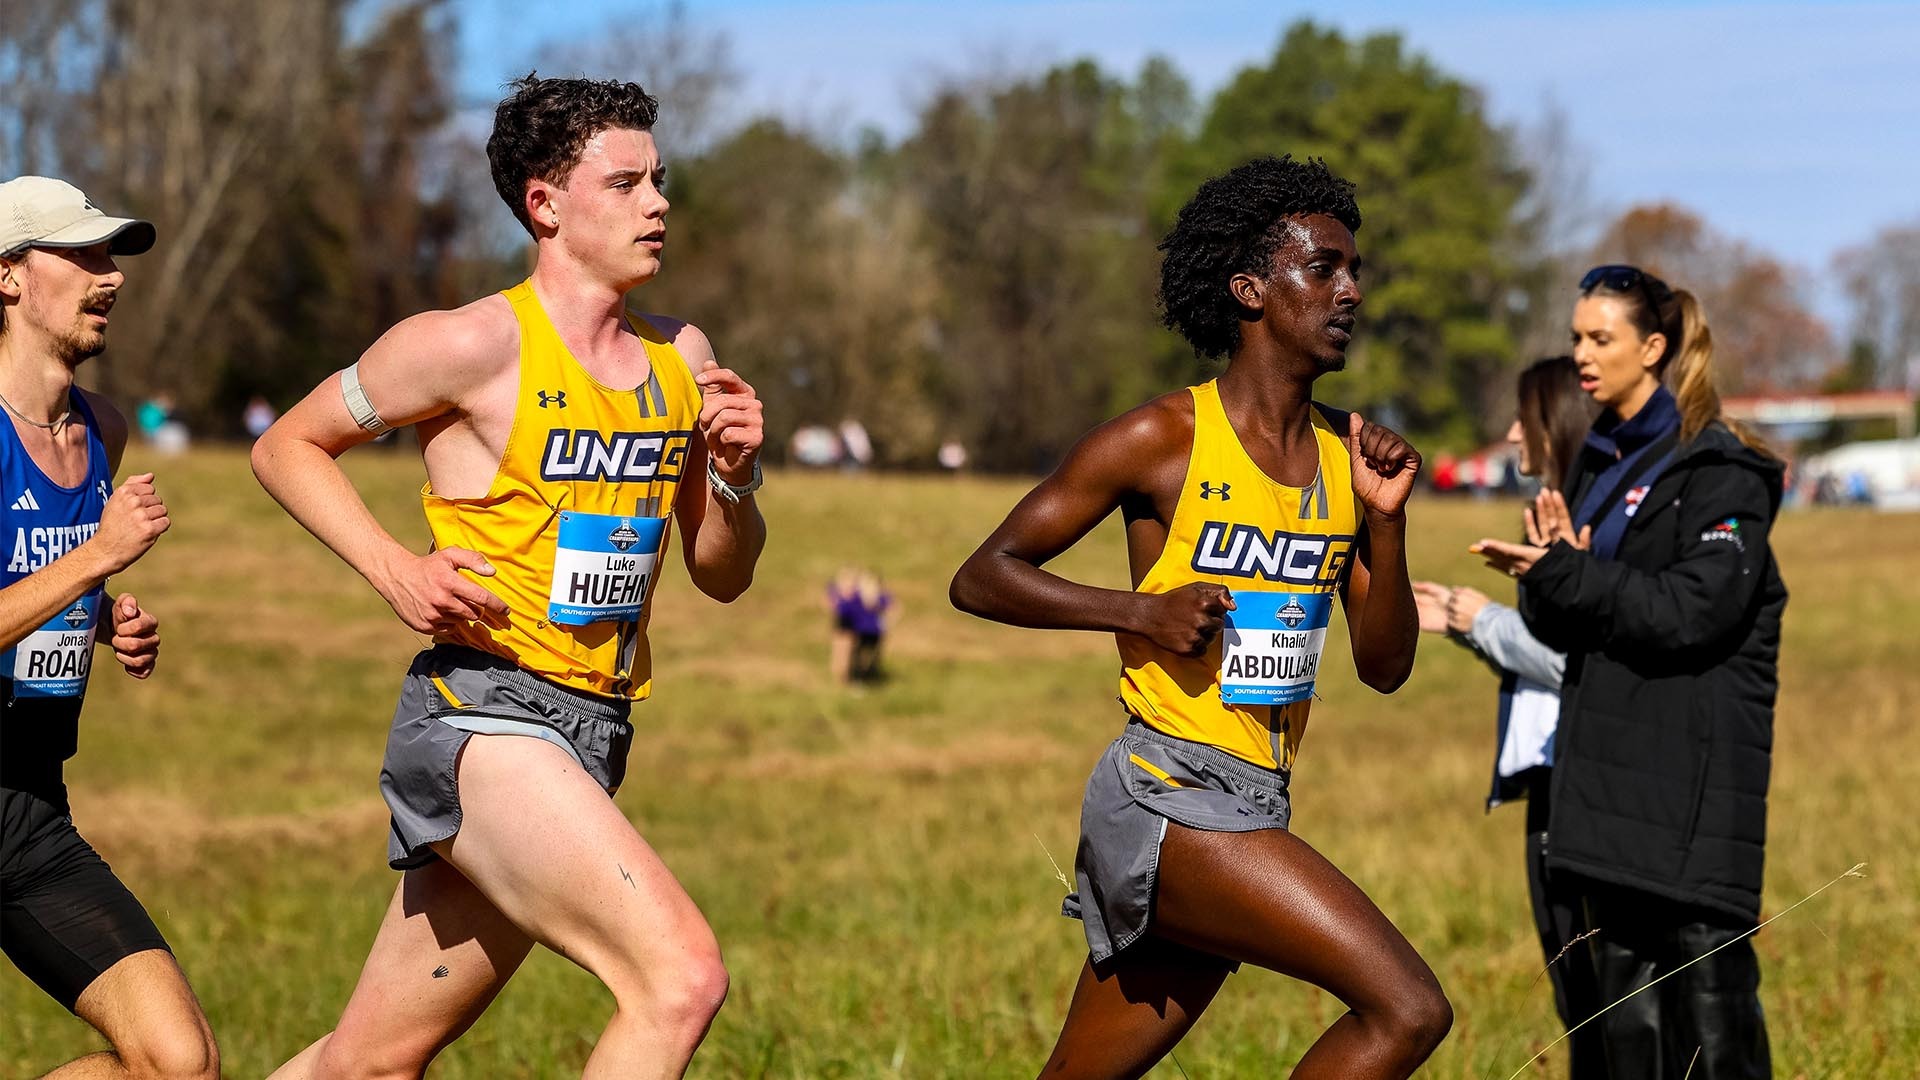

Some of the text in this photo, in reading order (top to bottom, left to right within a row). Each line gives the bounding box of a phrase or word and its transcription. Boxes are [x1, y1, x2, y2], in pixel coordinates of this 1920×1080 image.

[541, 430, 692, 482] UNCG
[1192, 521, 1353, 585] UNCG
[606, 555, 636, 571] Luke
[560, 607, 591, 616] SOUTHEAST
[57, 633, 88, 647] Jonas
[1271, 633, 1307, 648] Khalid
[1226, 653, 1318, 679] ABDULLAHI
[1234, 687, 1266, 695] SOUTHEAST
